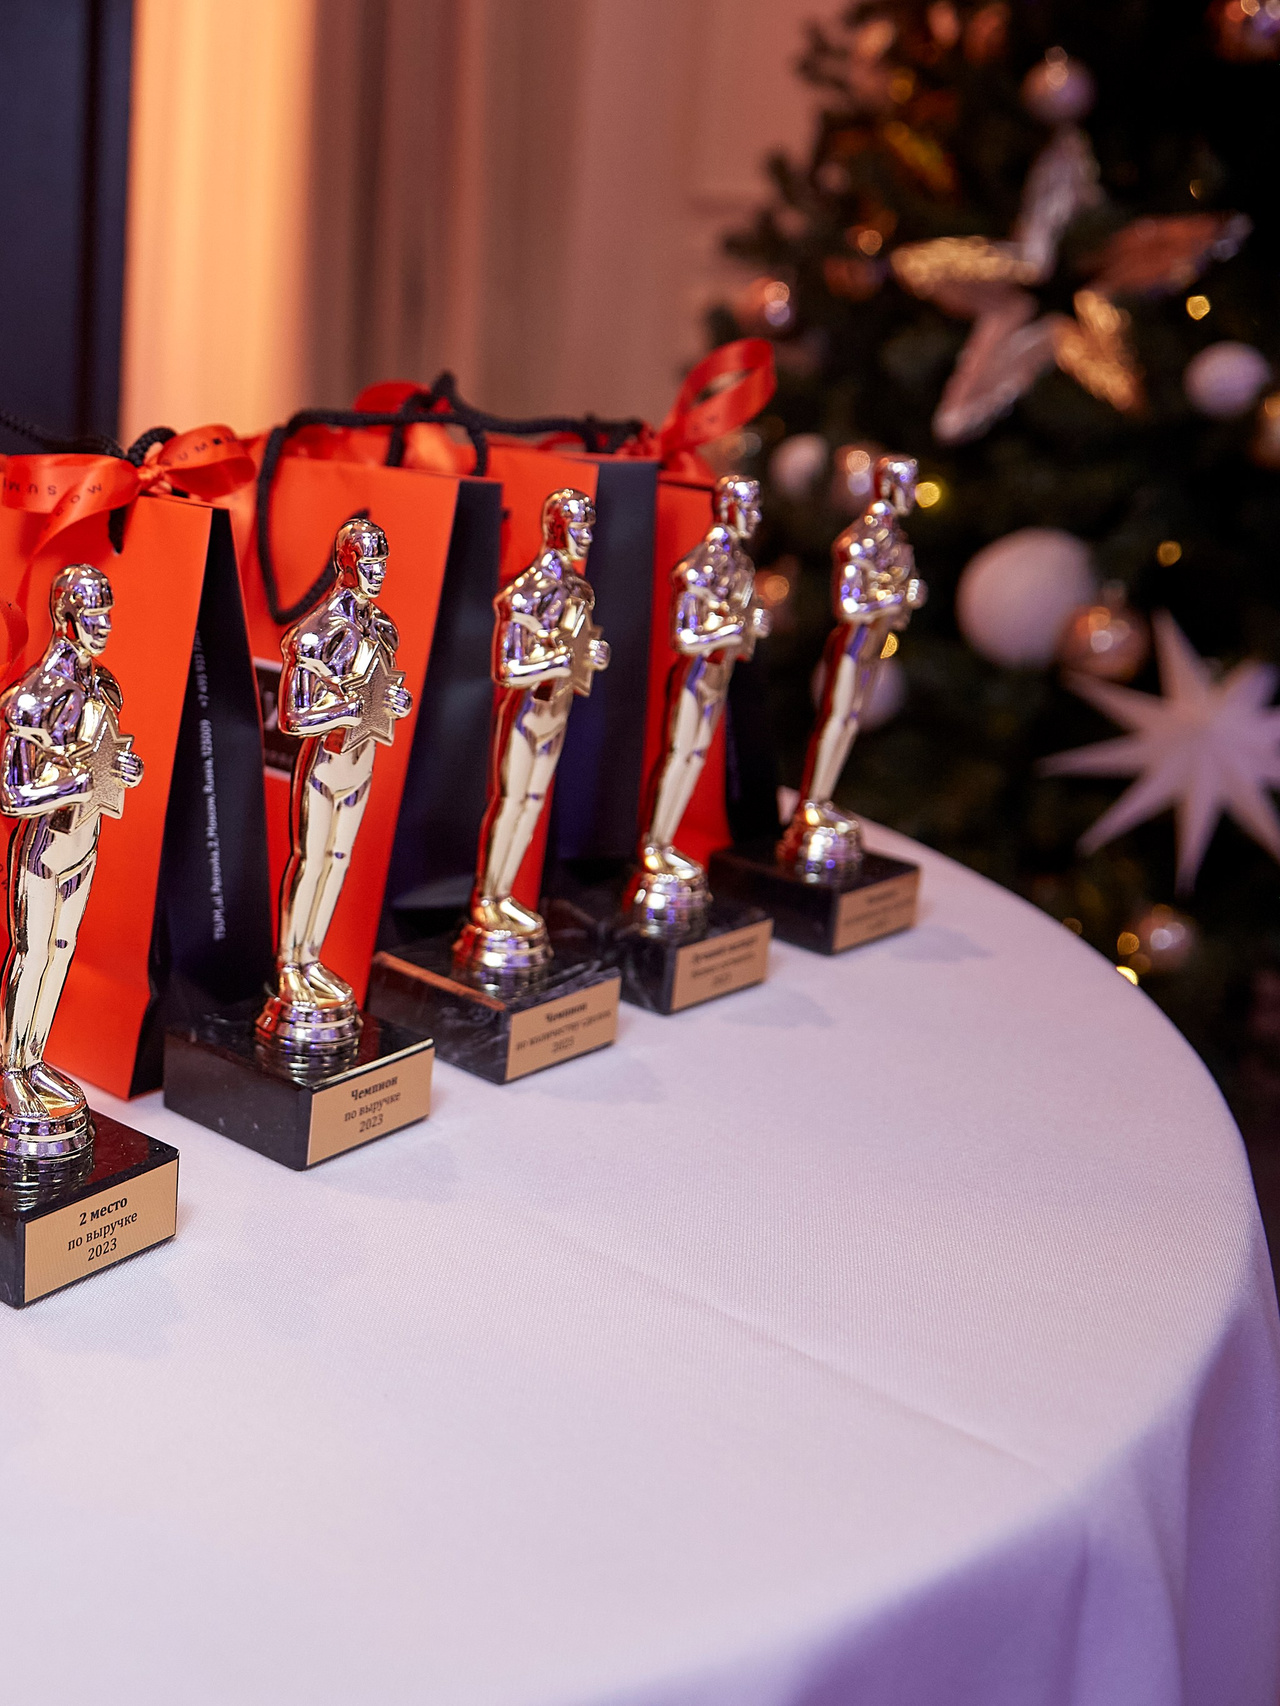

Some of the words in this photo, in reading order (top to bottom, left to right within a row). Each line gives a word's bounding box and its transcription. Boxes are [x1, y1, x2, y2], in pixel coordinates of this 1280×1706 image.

[351, 1076, 398, 1101] Чемпион
[344, 1110, 357, 1122] по
[359, 1092, 402, 1116] выручке
[359, 1114, 384, 1132] 2023
[78, 1212, 88, 1227] 2
[90, 1197, 128, 1222] место
[67, 1236, 83, 1252] по
[86, 1212, 138, 1244] выручке
[87, 1237, 118, 1262] 2023
